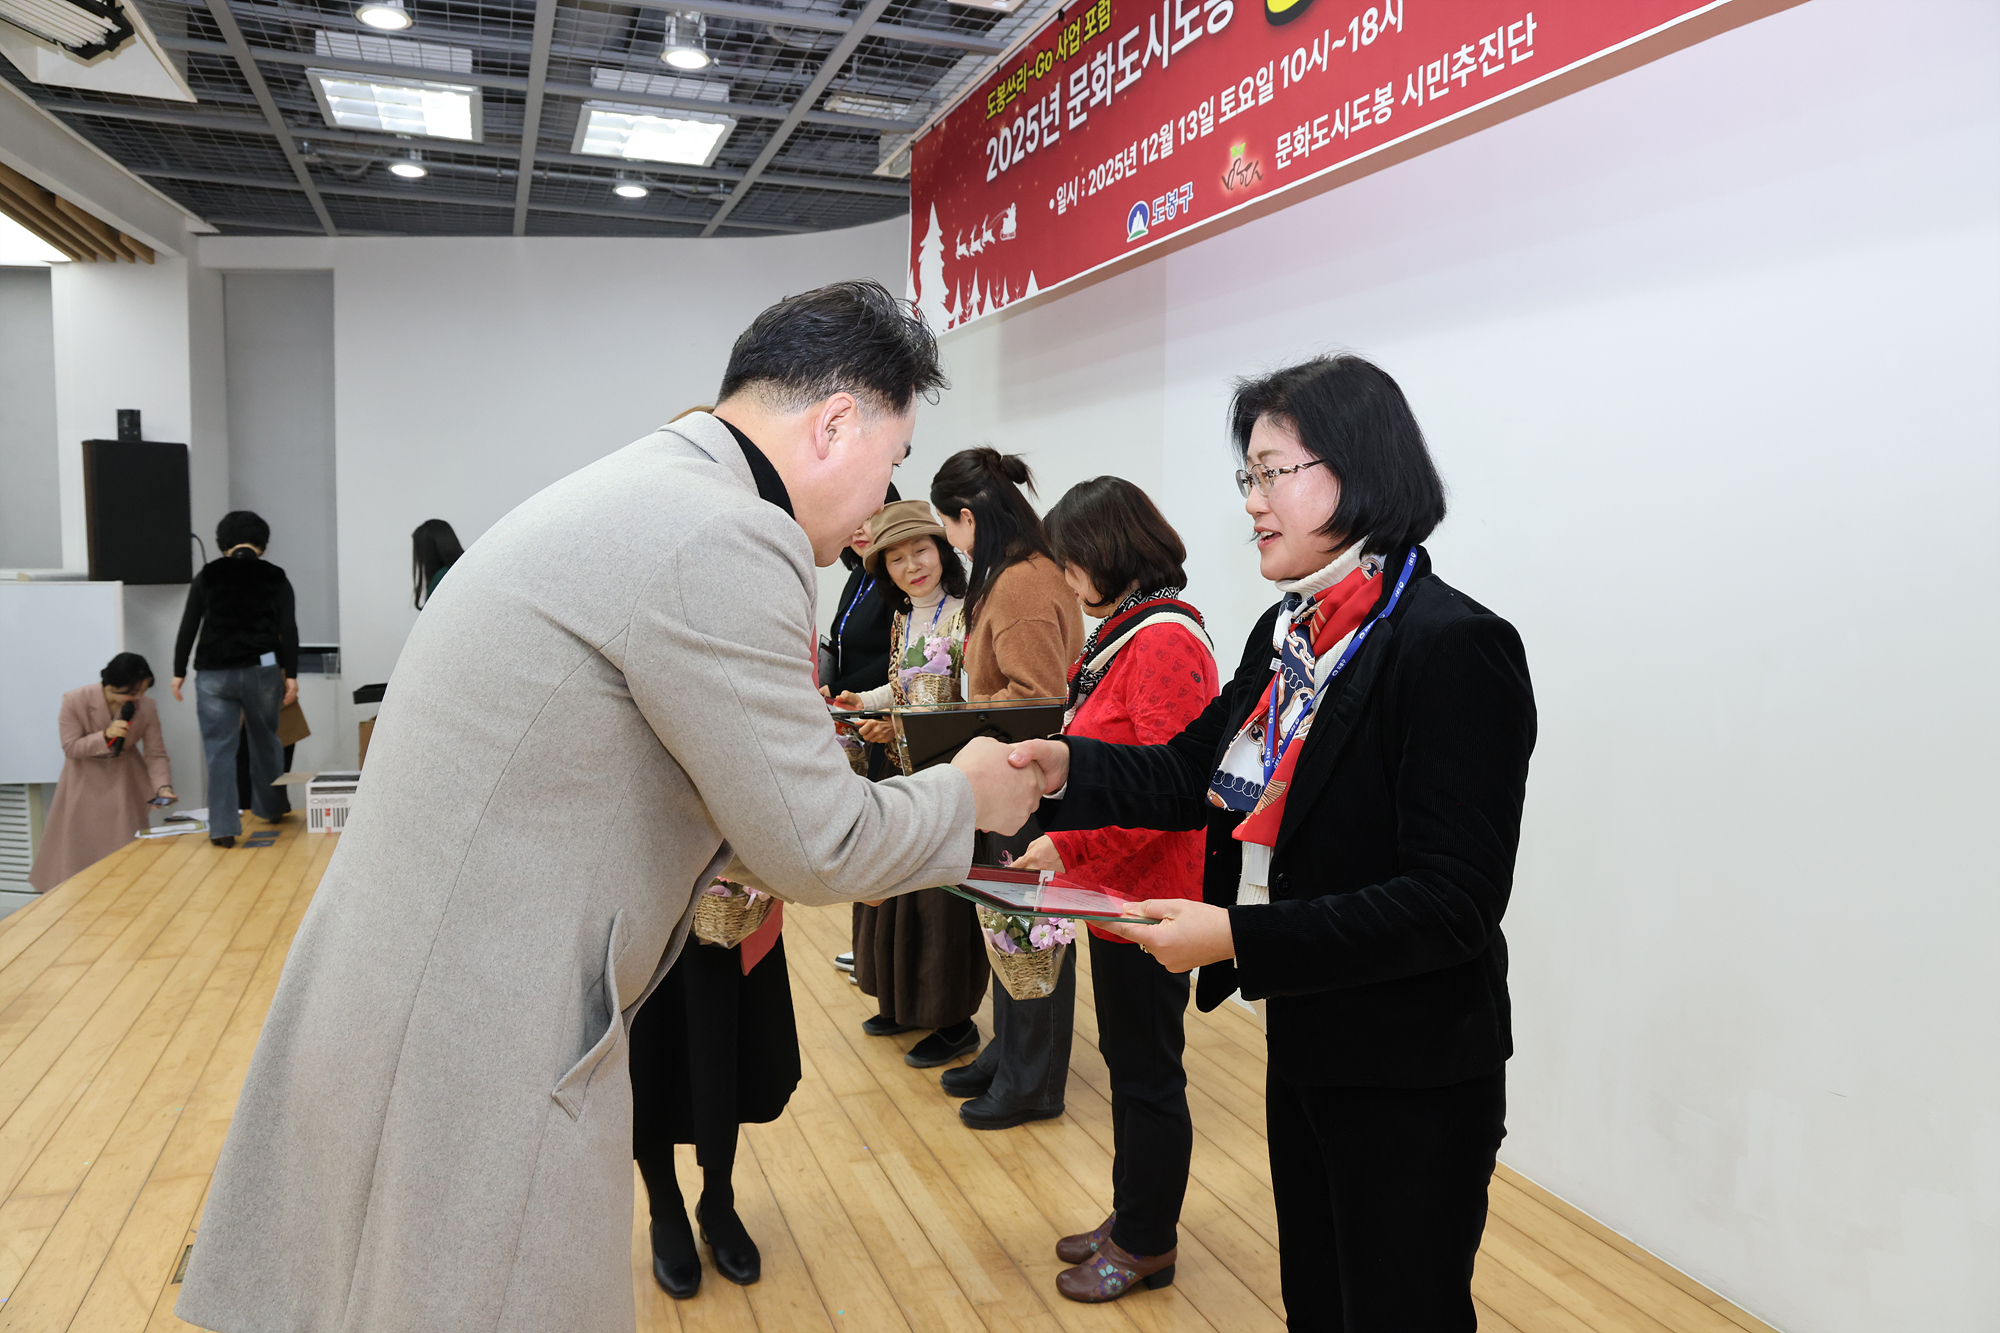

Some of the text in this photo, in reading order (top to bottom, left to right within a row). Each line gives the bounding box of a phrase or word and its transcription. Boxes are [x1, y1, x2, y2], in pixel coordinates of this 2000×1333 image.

[986, 0, 1111, 119] 도봉쓰리~Go 사업 포럼
[1088, 141, 1137, 196] 2025년
[1141, 119, 1174, 167] 12월
[1178, 96, 1214, 145] 13일
[1219, 61, 1274, 124] 토요일
[1280, 0, 1404, 89] 10시~18시
[1275, 11, 1537, 170] 문화도시도봉 시민추진단
[986, 82, 1060, 182] 2025년
[1151, 181, 1194, 226] 도봉구
